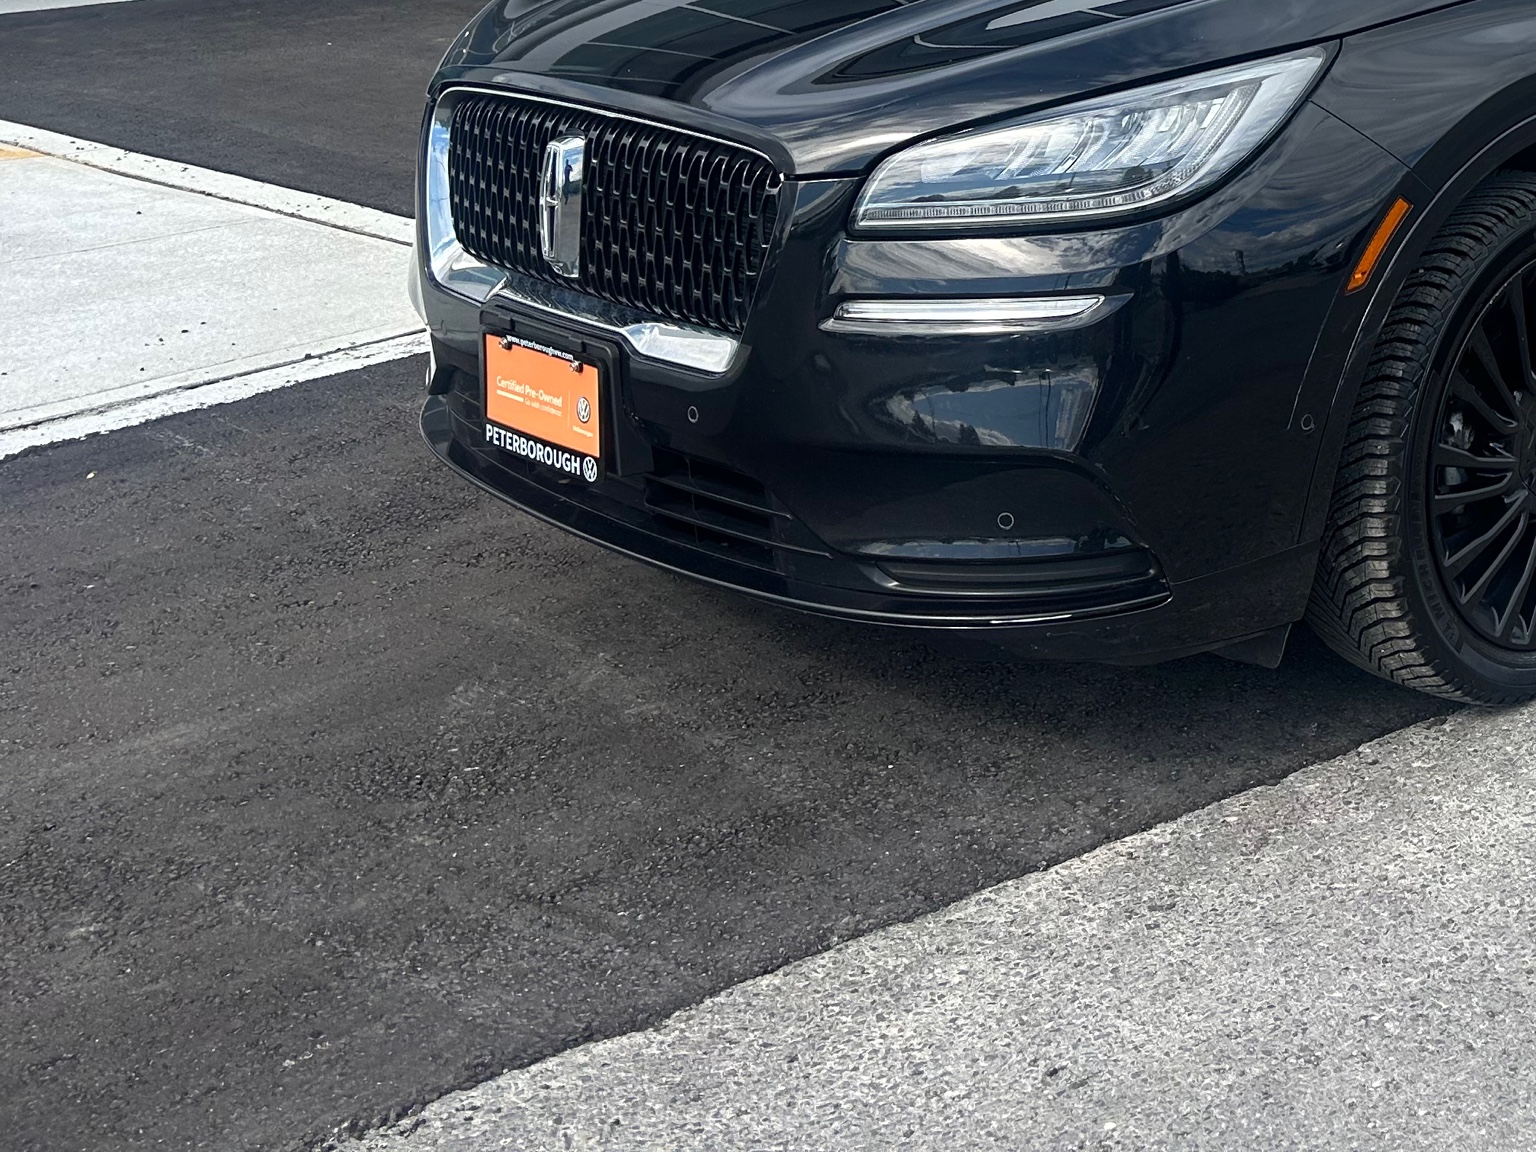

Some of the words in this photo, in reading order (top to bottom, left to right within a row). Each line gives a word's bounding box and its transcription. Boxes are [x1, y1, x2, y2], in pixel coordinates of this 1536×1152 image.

[496, 376, 525, 394] Certified
[525, 384, 563, 408] Pre-Owned
[486, 424, 581, 476] PETERBOROUGH
